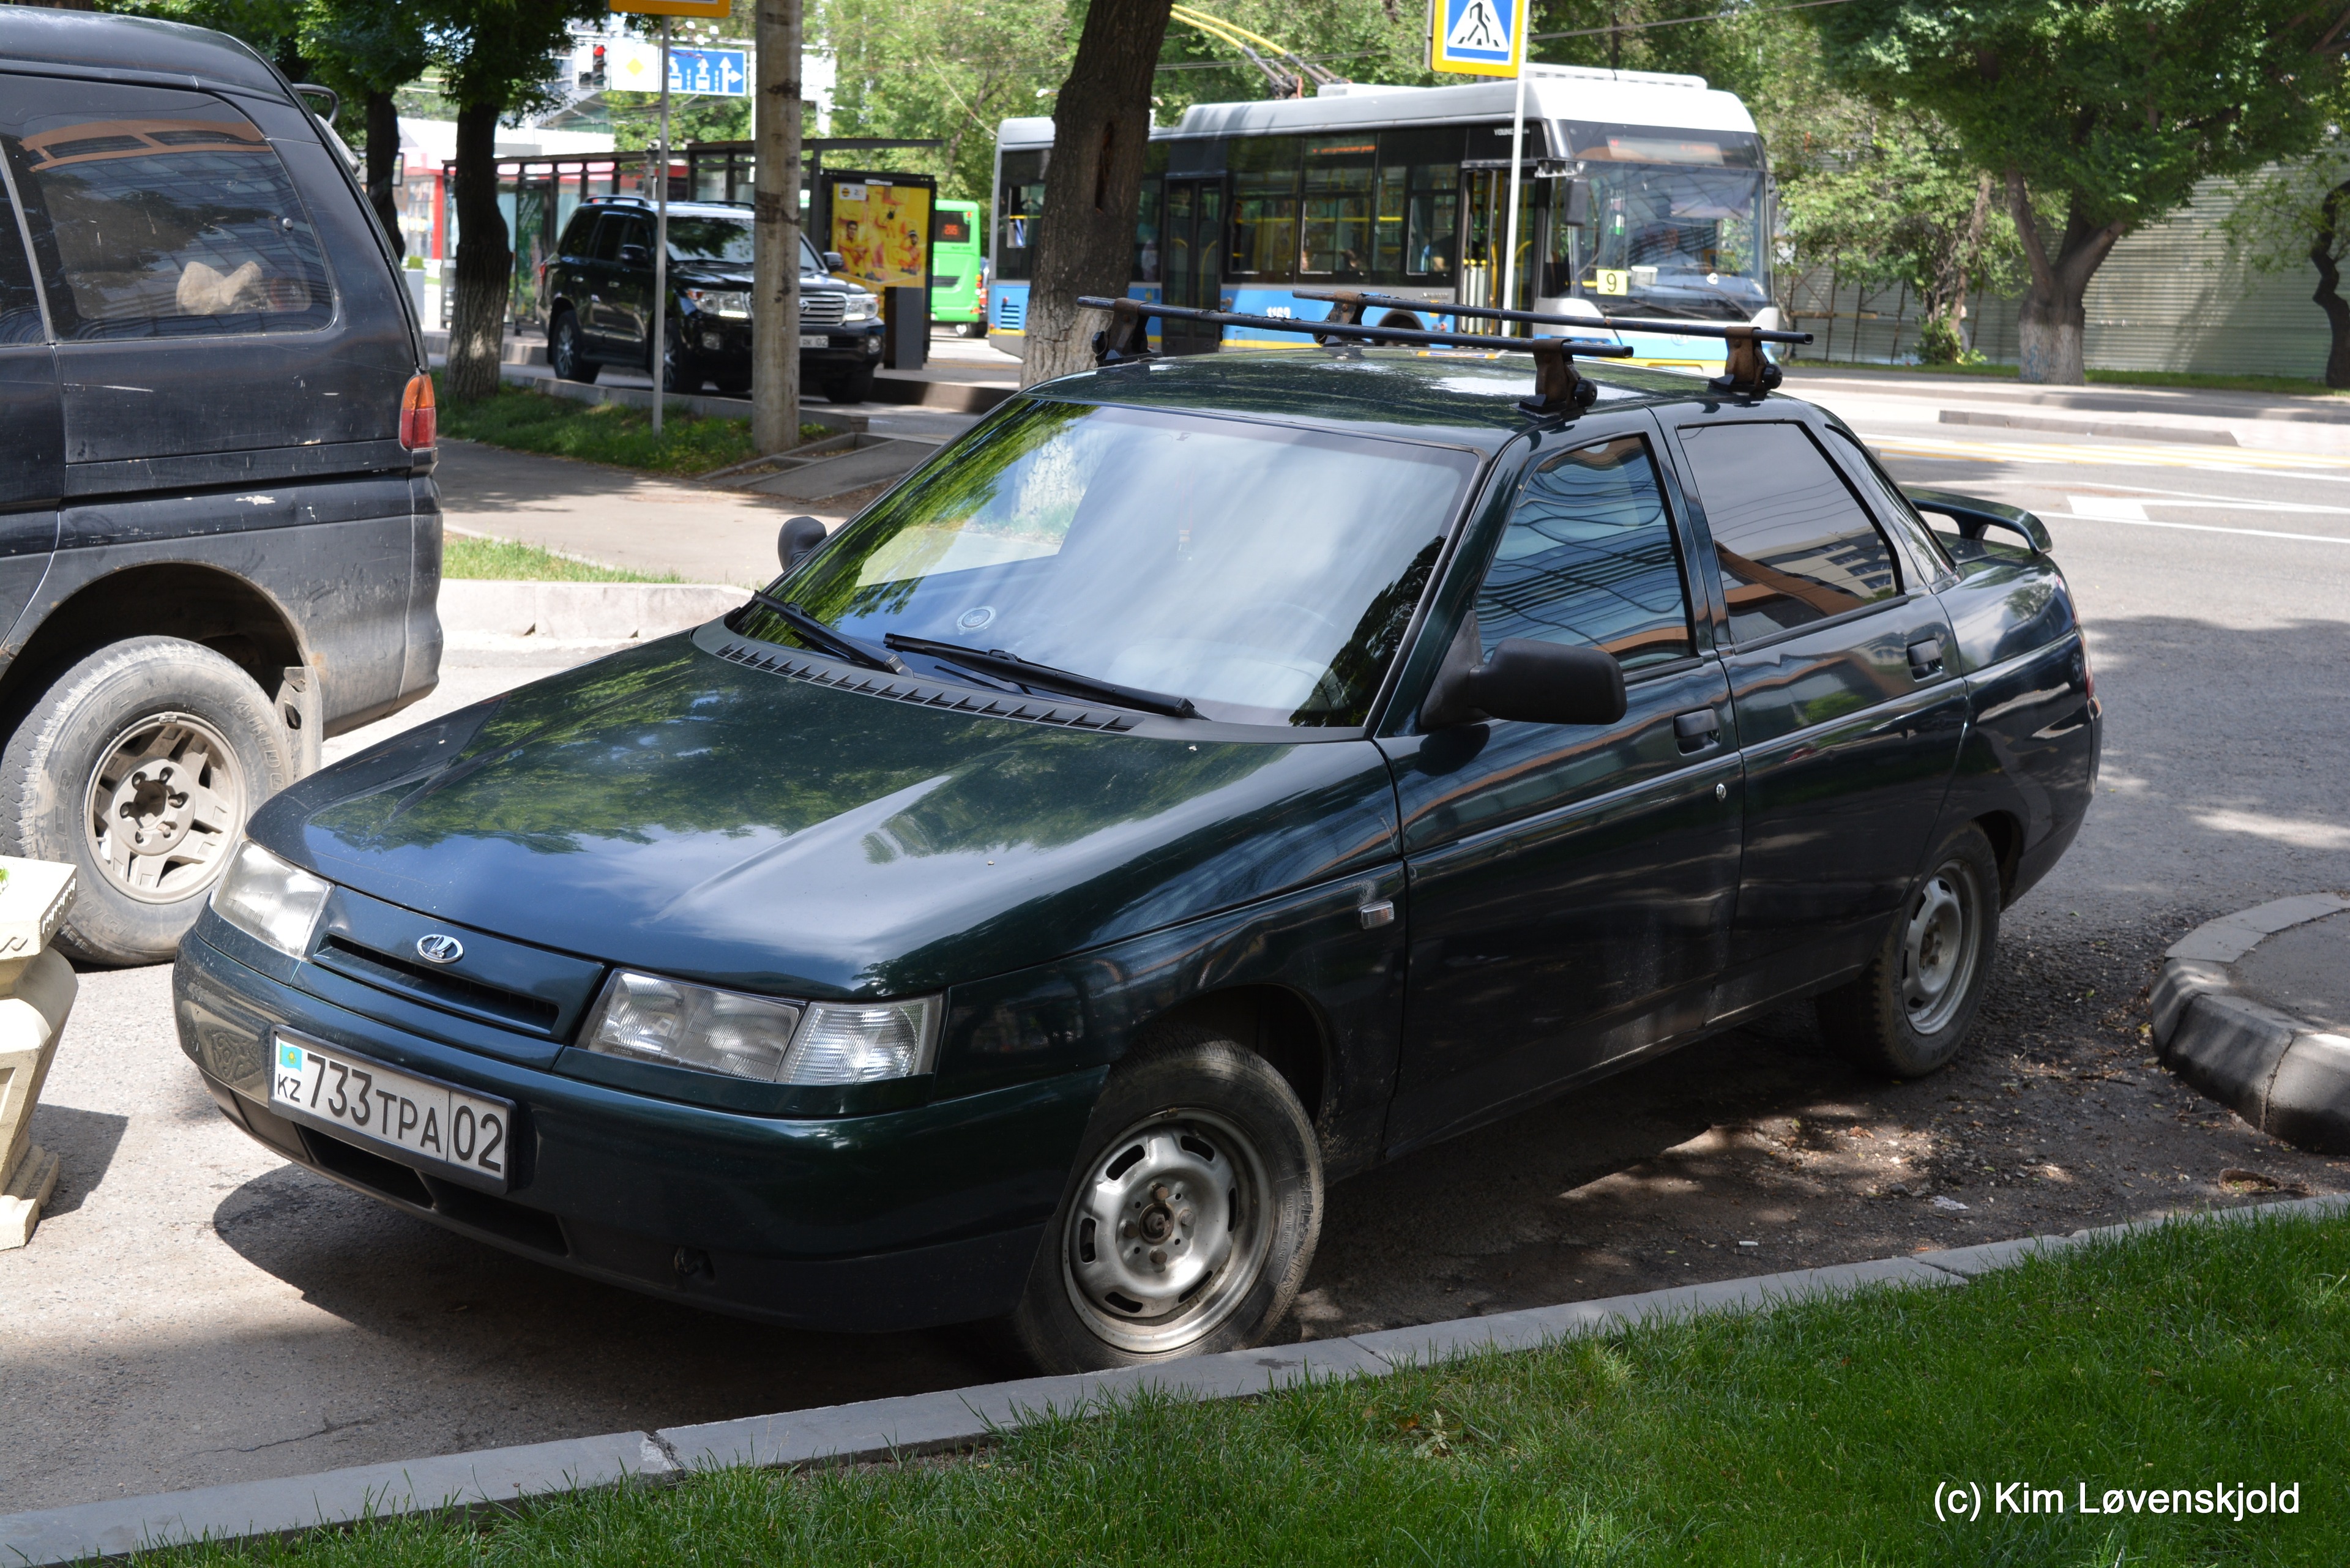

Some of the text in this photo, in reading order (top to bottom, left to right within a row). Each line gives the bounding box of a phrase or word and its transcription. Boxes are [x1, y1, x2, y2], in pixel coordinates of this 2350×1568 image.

[1494, 127, 1530, 136] YOUNGN
[1606, 273, 1617, 292] 9
[277, 1073, 301, 1102] KZ
